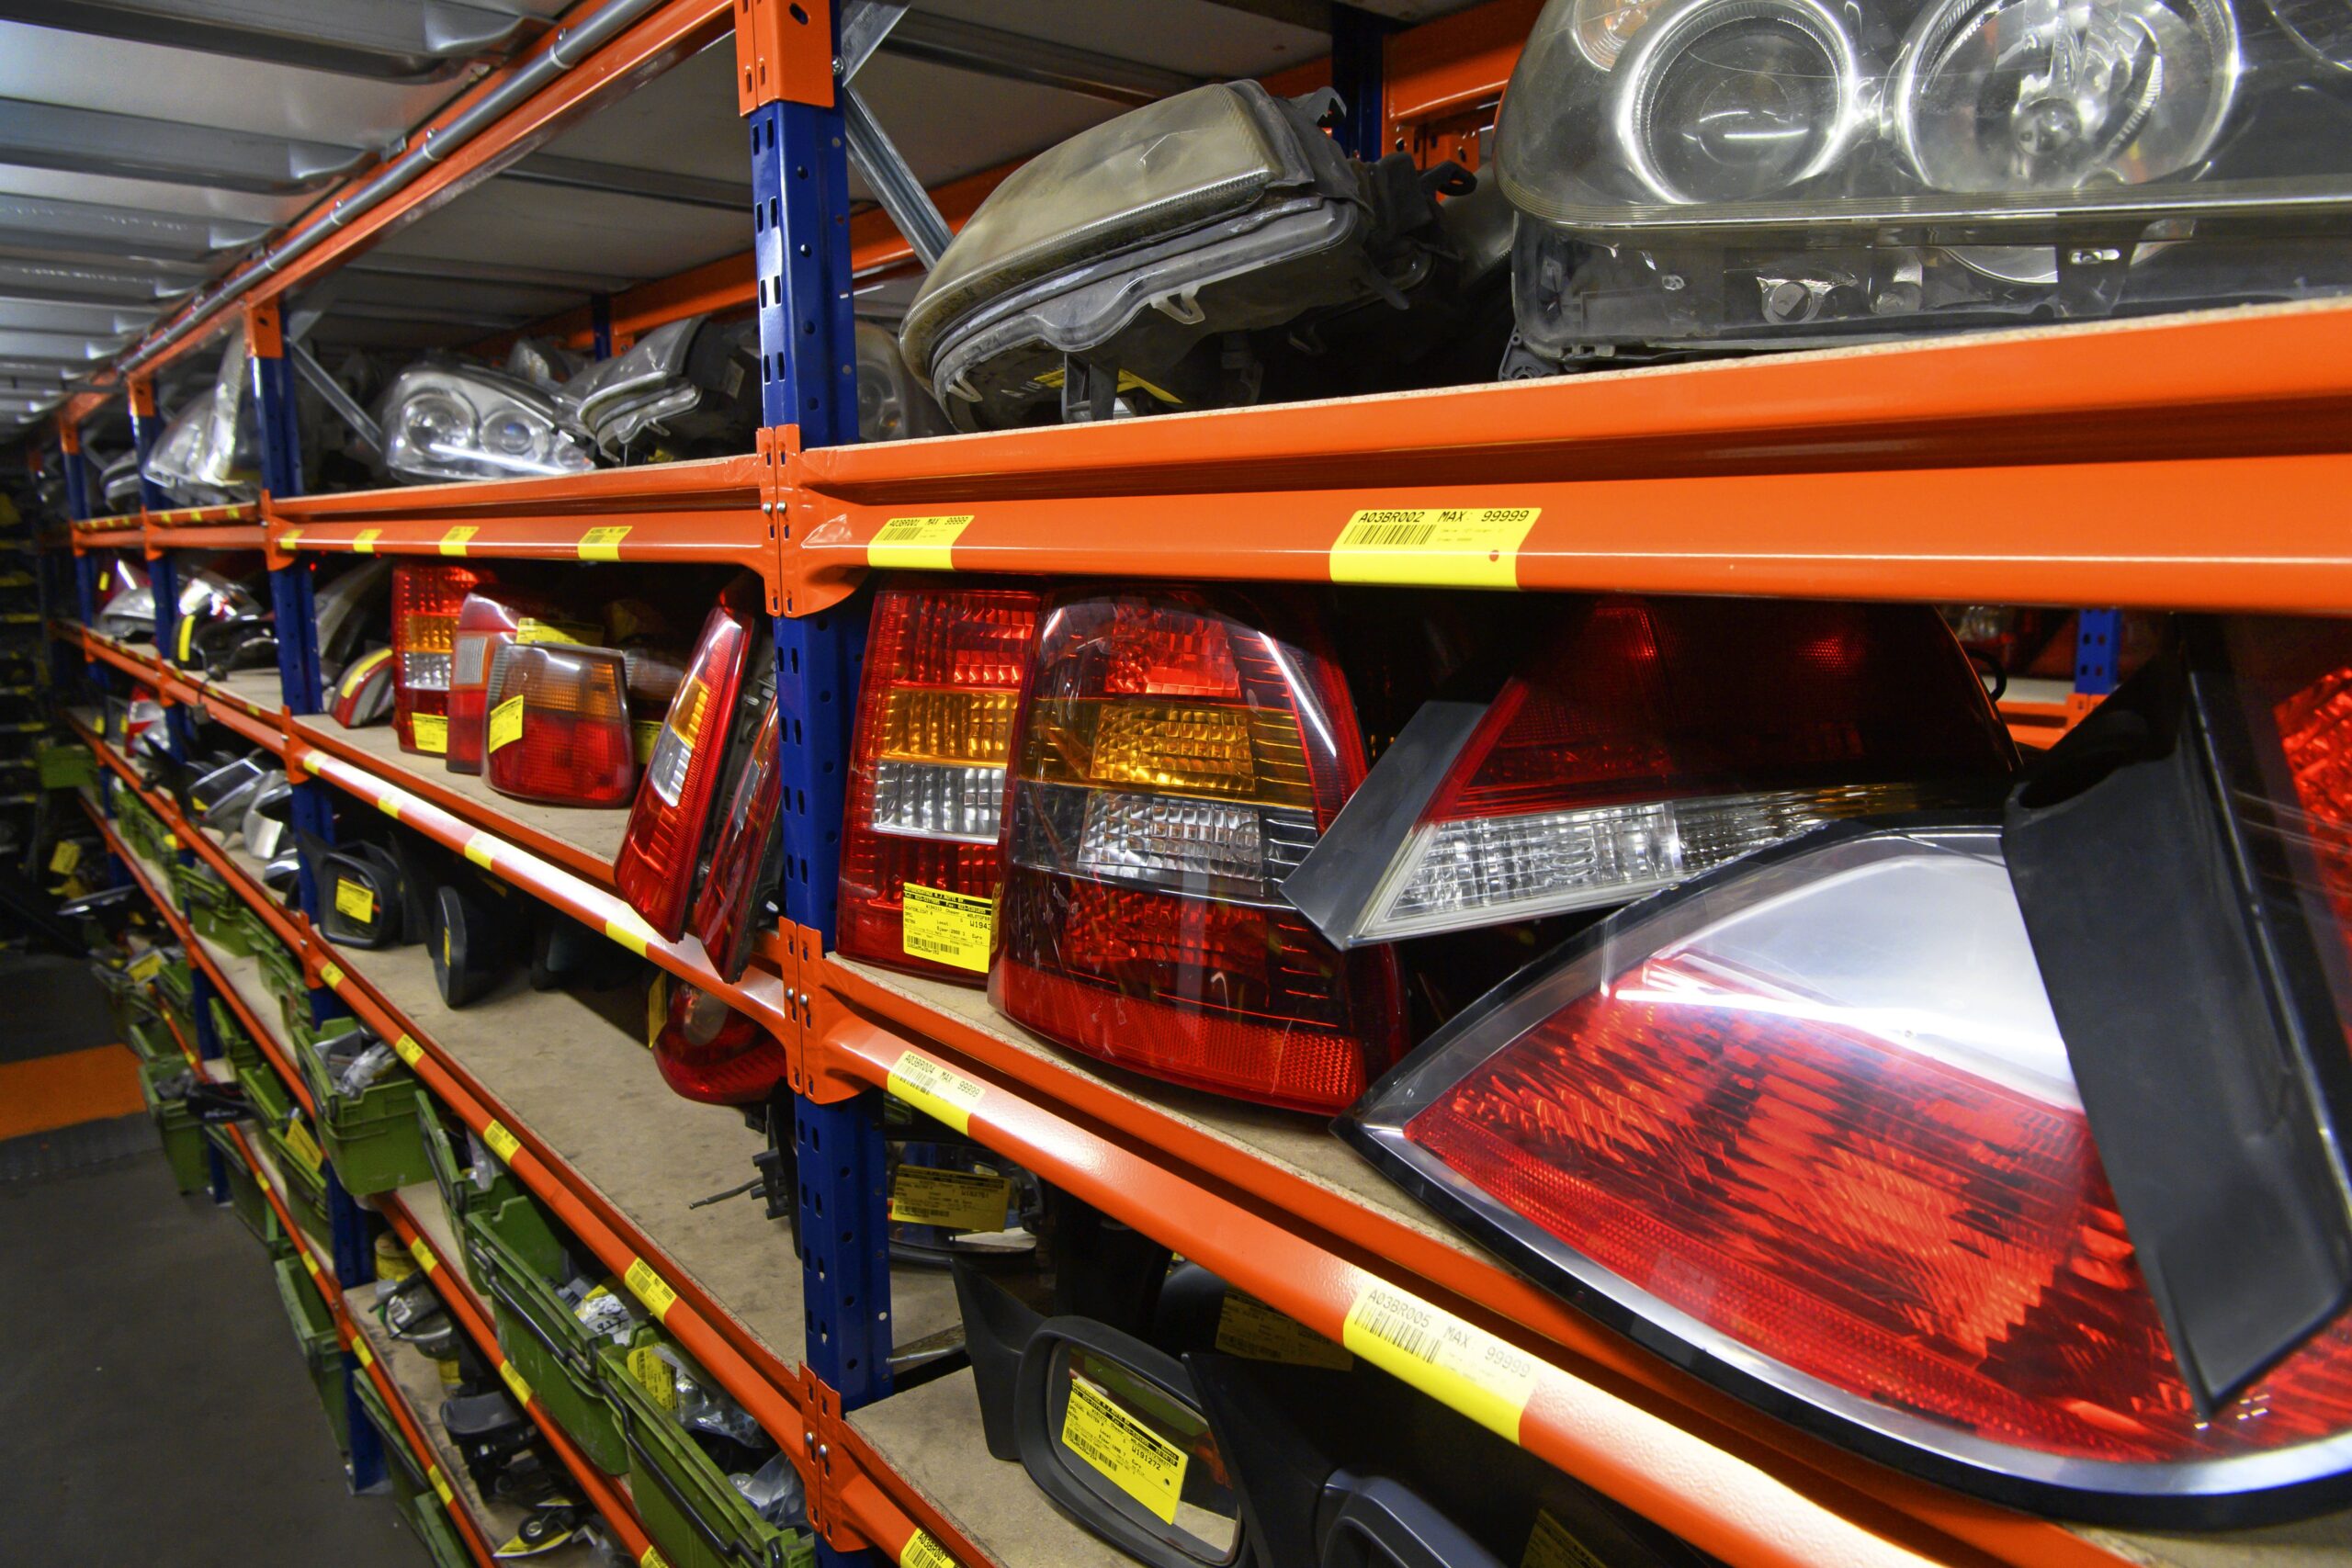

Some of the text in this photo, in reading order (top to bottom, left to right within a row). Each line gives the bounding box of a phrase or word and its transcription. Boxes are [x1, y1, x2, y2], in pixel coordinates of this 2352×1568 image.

[1358, 512, 1425, 524] A03BR002
[1481, 510, 1530, 523] 99999
[905, 1054, 936, 1075] A03BR004
[957, 1080, 980, 1098] 99999
[1367, 1289, 1432, 1328] A03BR005
[1484, 1346, 1532, 1379] 99999
[1131, 1445, 1161, 1472] W191272
[917, 1533, 948, 1563] A03BR007
